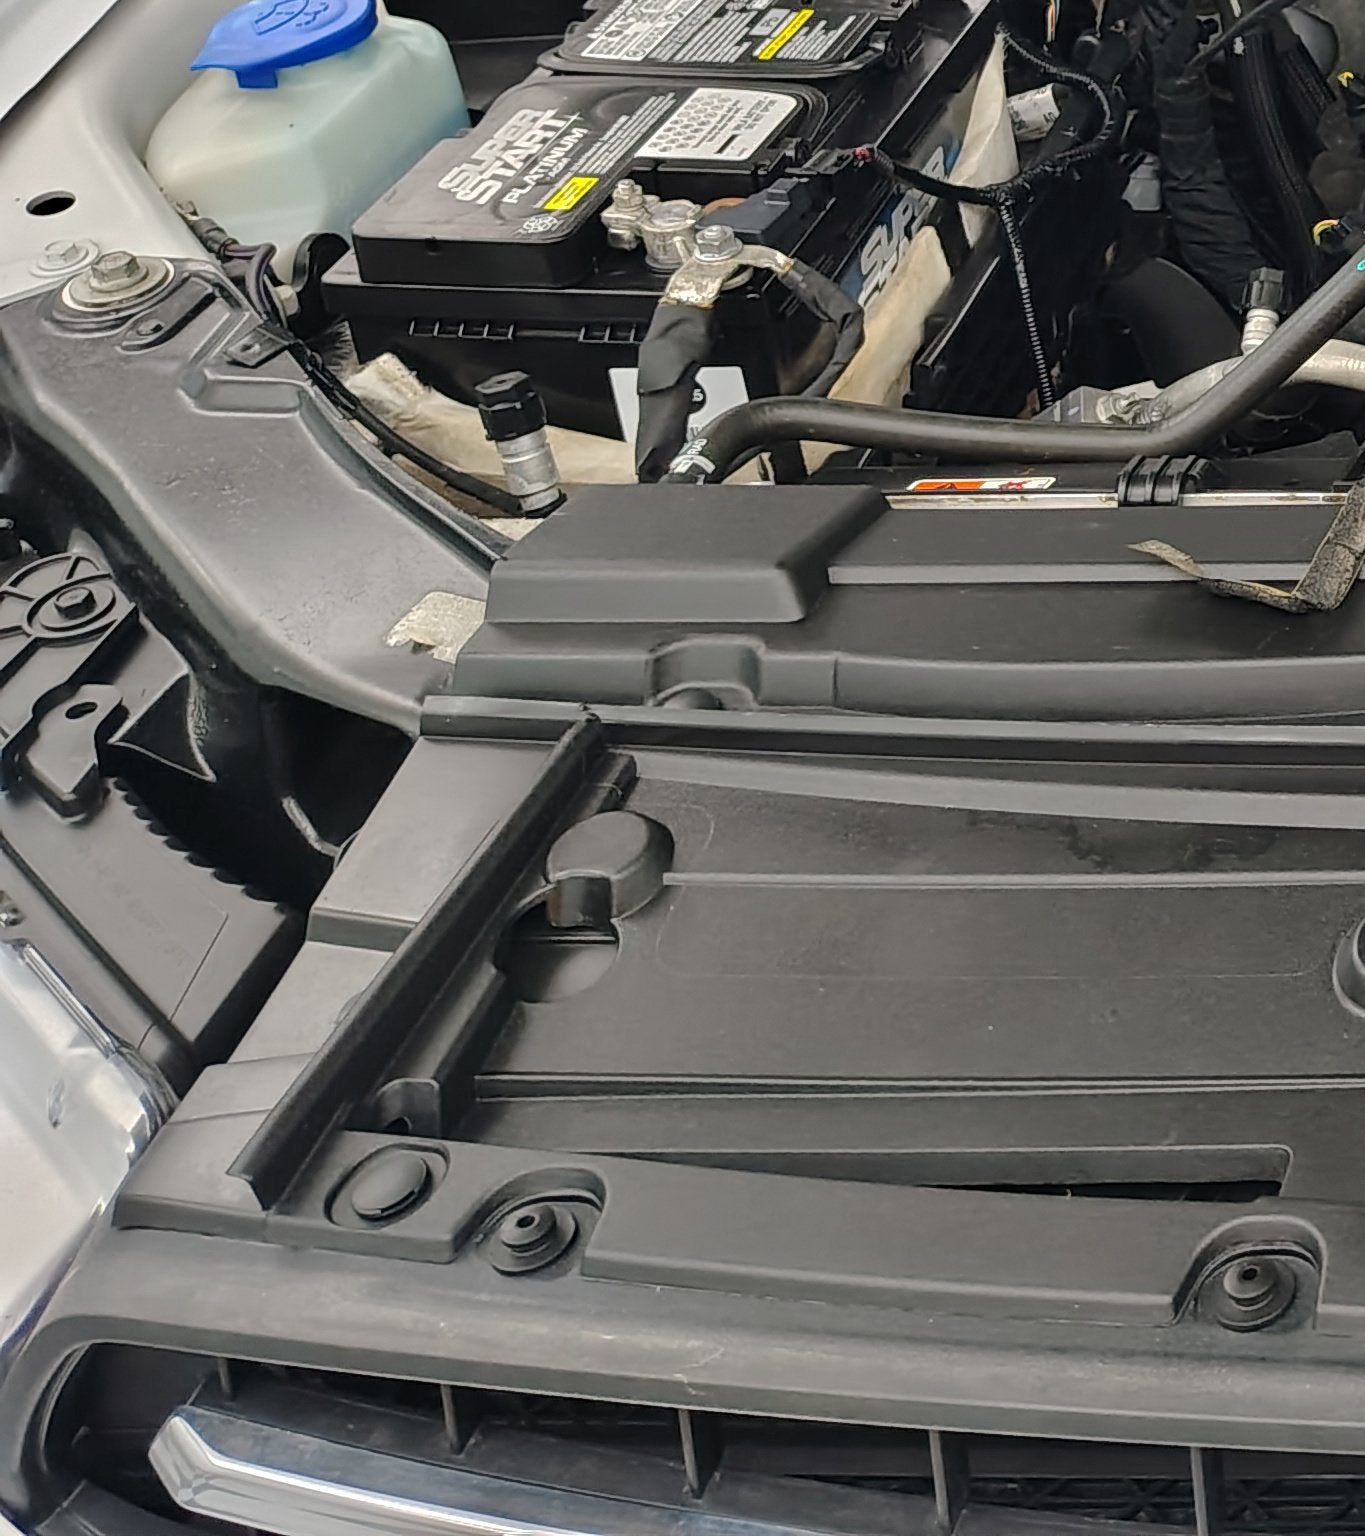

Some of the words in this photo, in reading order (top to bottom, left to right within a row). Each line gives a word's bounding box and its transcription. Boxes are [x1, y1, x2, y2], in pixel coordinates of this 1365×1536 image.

[437, 108, 546, 191] SUPER
[455, 107, 568, 205] START
[501, 127, 589, 204] PLATINUM
